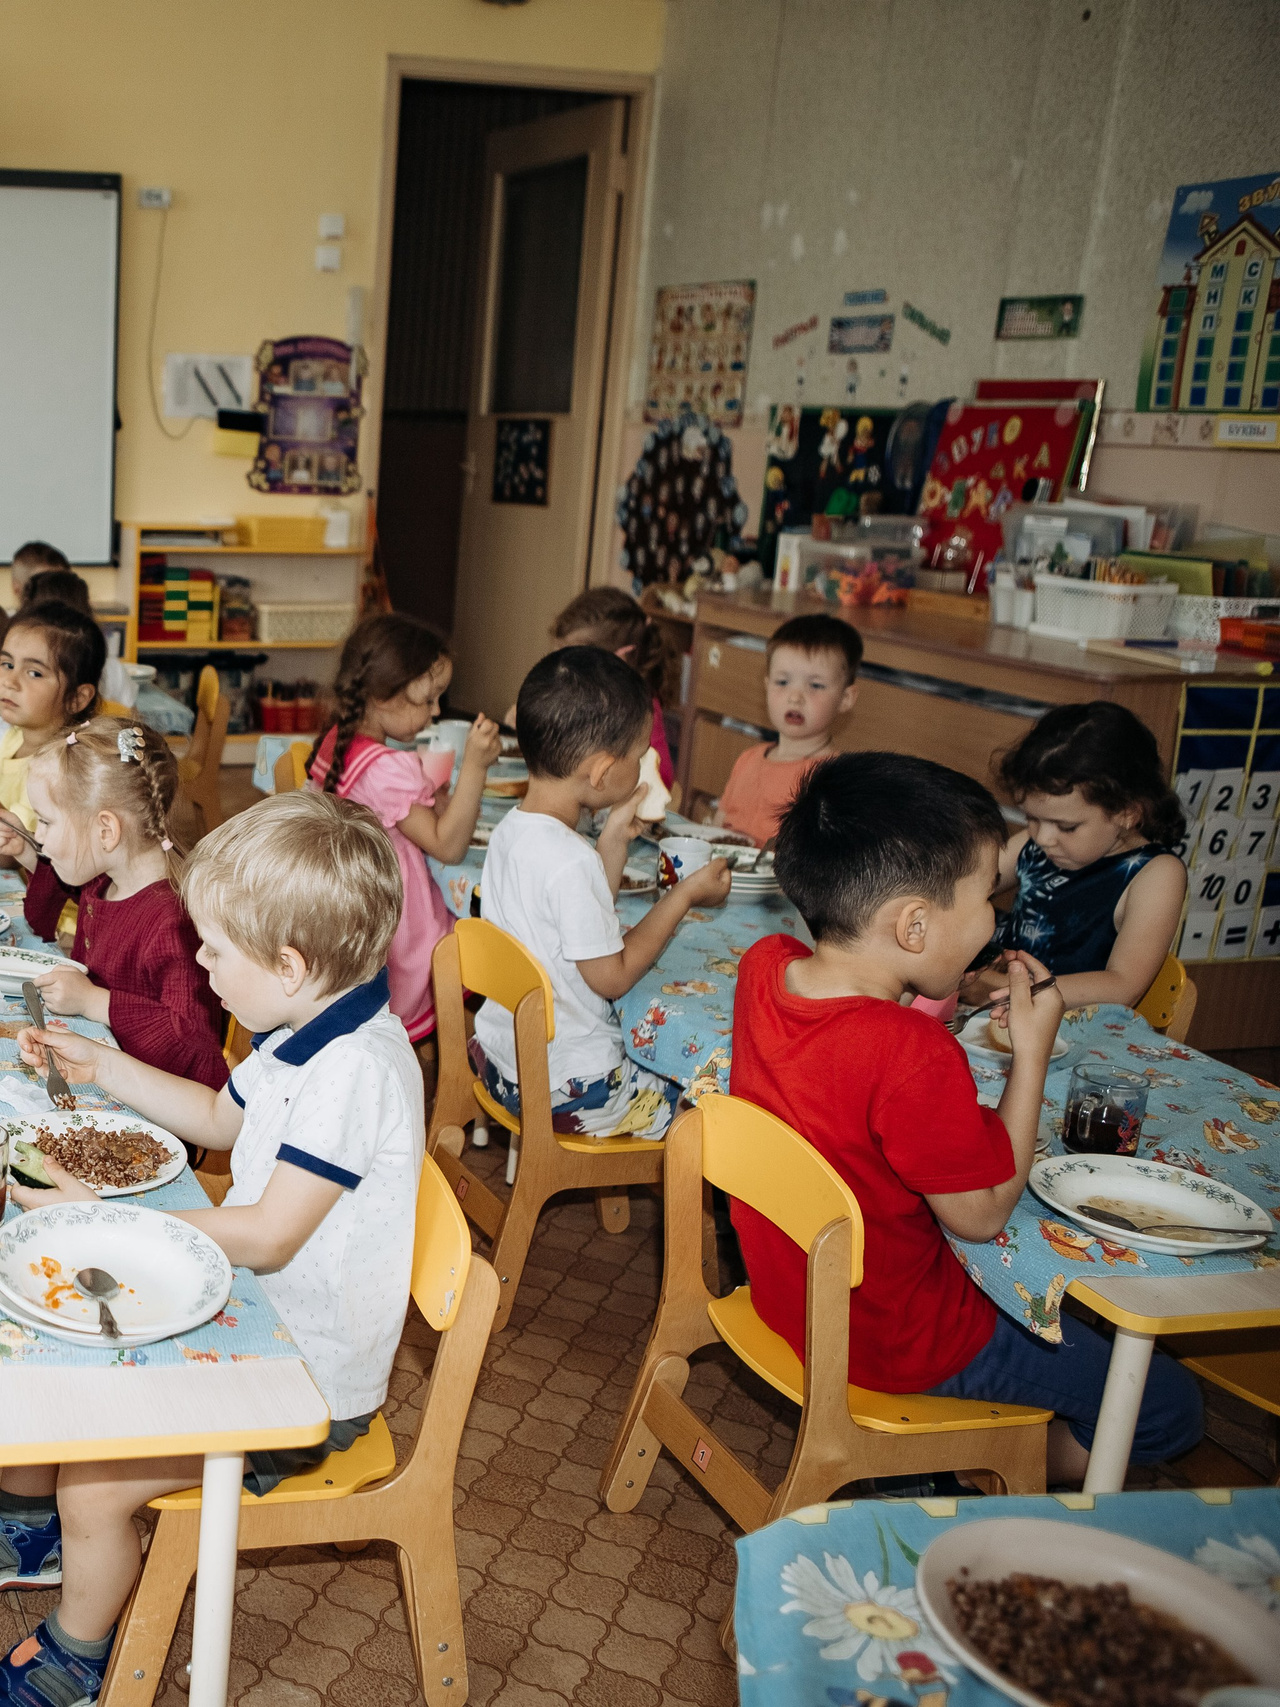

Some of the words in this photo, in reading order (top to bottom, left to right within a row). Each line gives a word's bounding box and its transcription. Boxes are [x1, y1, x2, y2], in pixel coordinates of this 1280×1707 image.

[1238, 182, 1280, 213] ЗВУ
[1211, 264, 1224, 278] М
[1248, 261, 1259, 277] С
[1207, 289, 1219, 304] Н
[1242, 289, 1254, 304] К
[1202, 314, 1214, 328] П
[1189, 780, 1202, 805] 1
[1214, 785, 1233, 812] 2
[1252, 784, 1272, 810] 3
[1209, 829, 1227, 855] 6
[1247, 830, 1266, 856] 7
[1199, 873, 1226, 901] 10
[1233, 879, 1252, 905] 0
